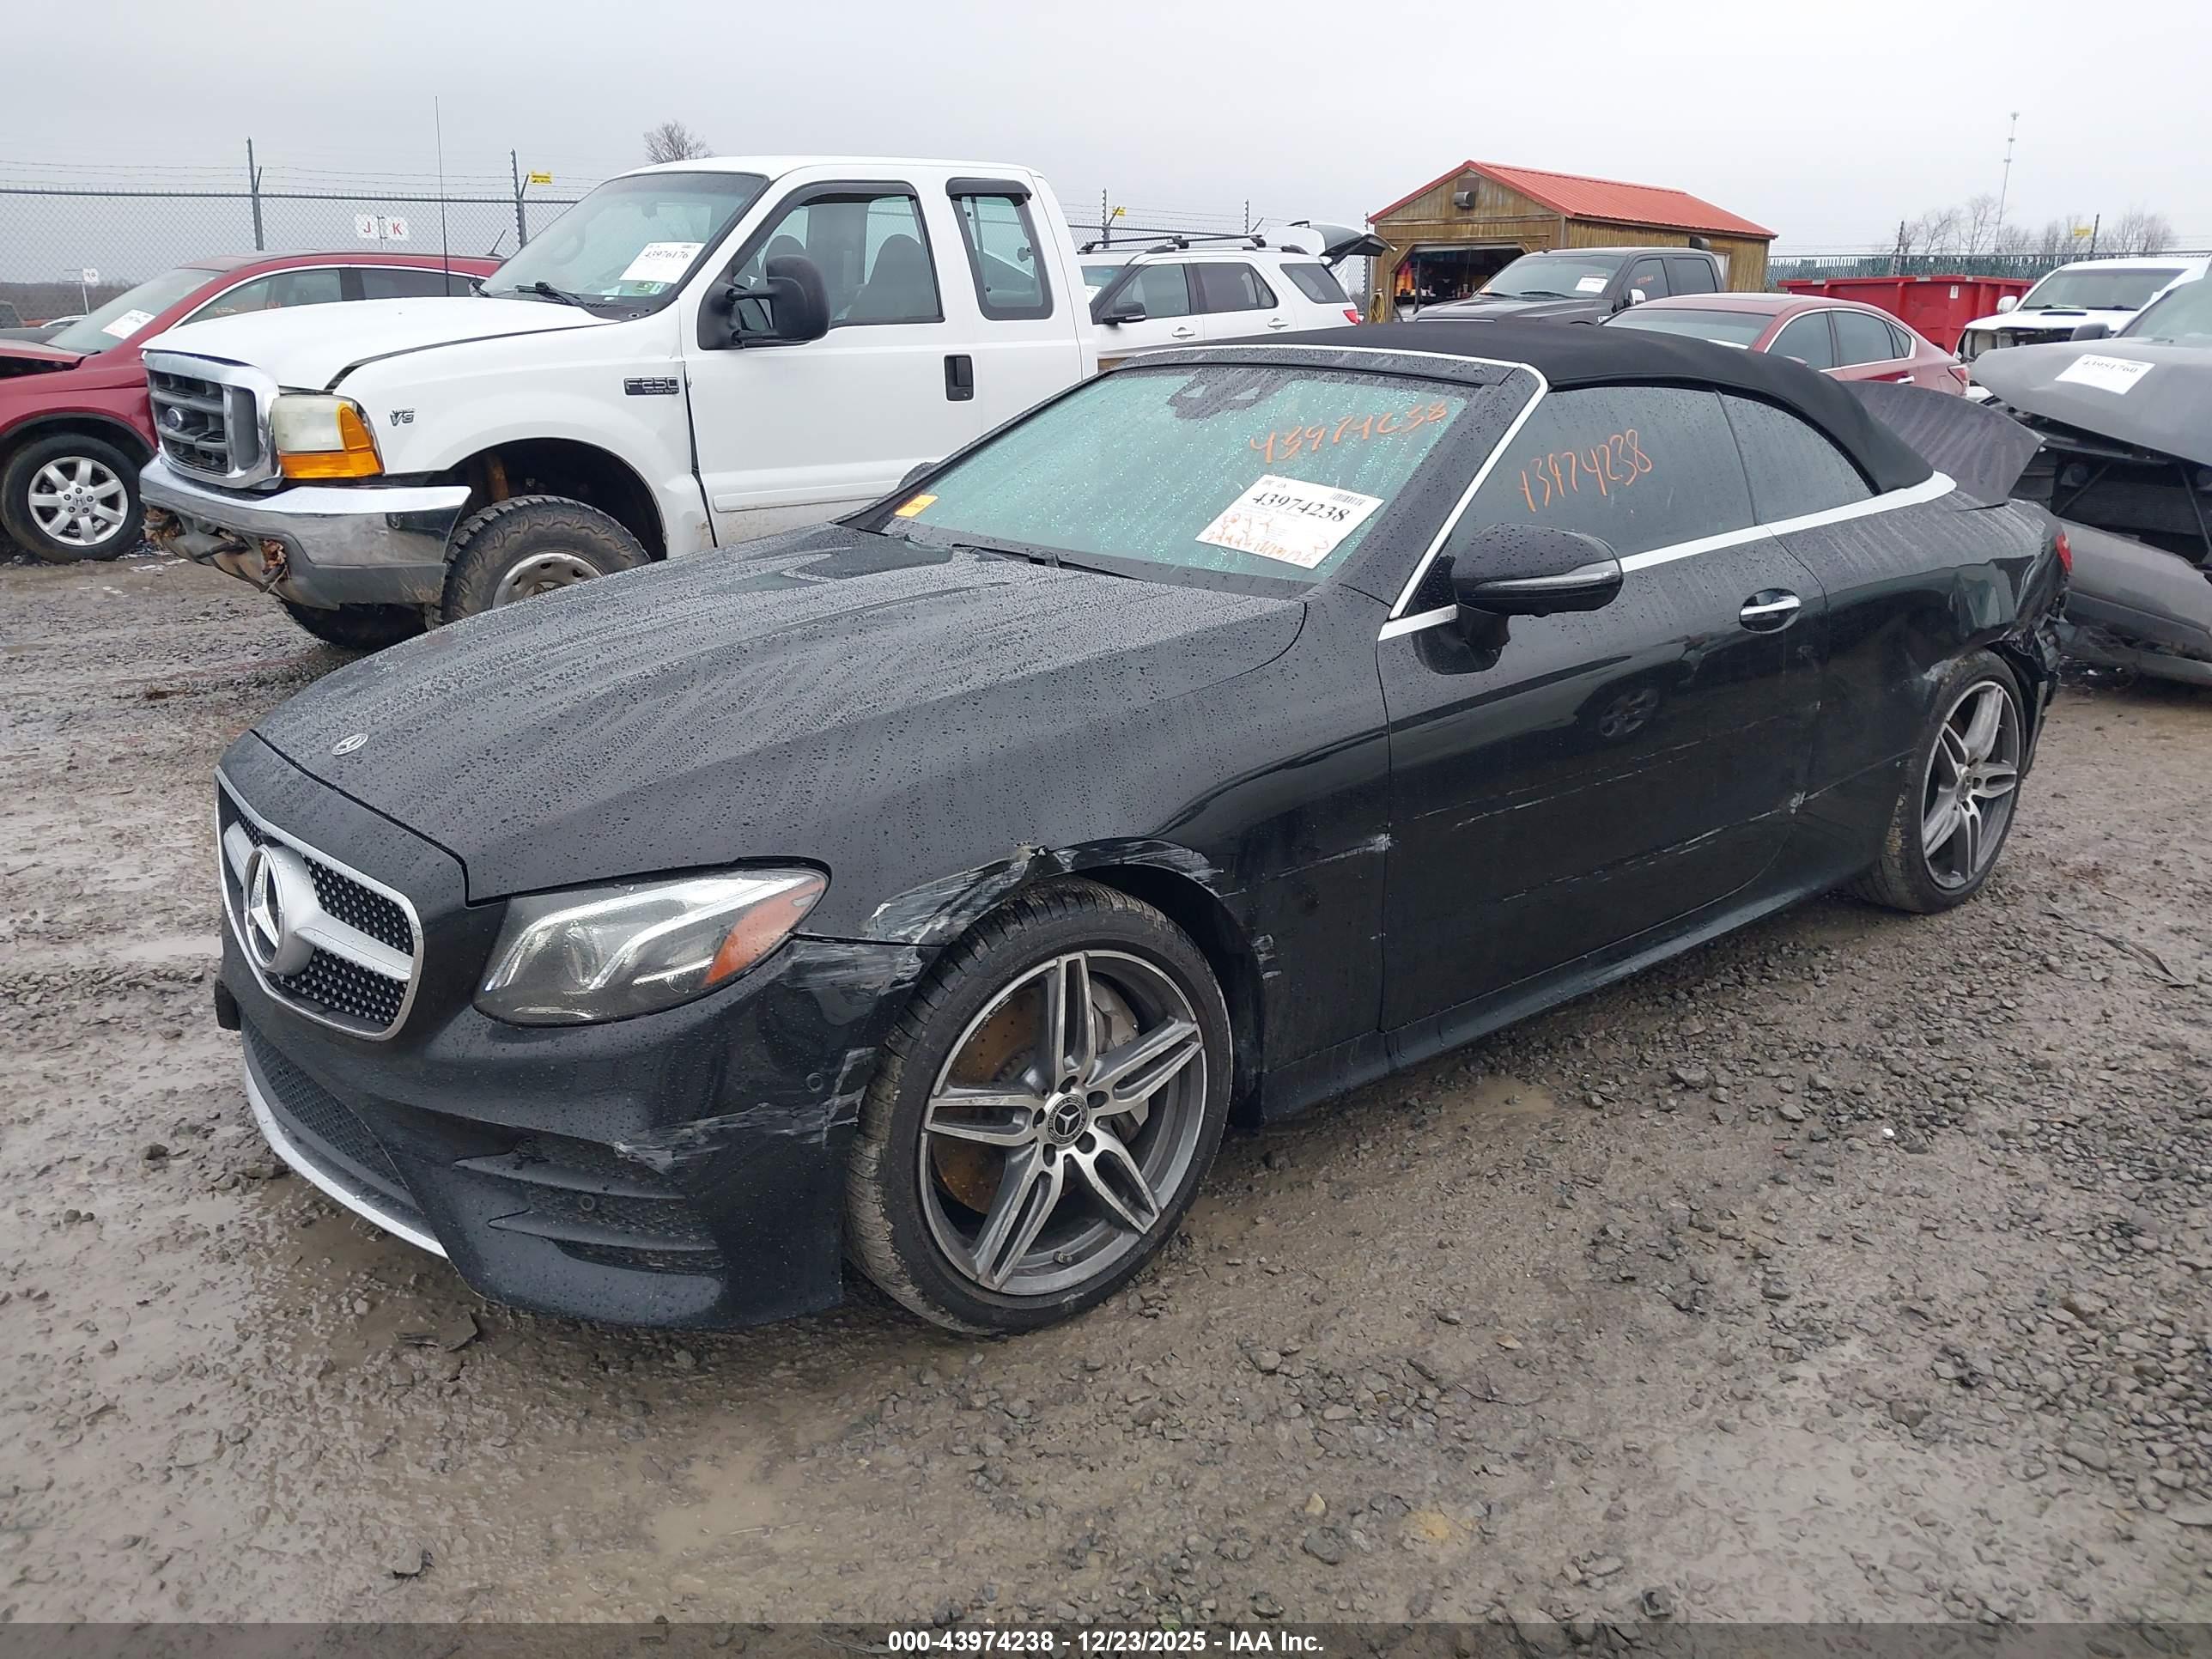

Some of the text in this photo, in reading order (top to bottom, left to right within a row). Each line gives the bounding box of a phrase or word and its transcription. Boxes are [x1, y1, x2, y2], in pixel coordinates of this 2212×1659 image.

[363, 221, 371, 234] J
[392, 222, 403, 235] K
[1252, 492, 1351, 522] 43974238
